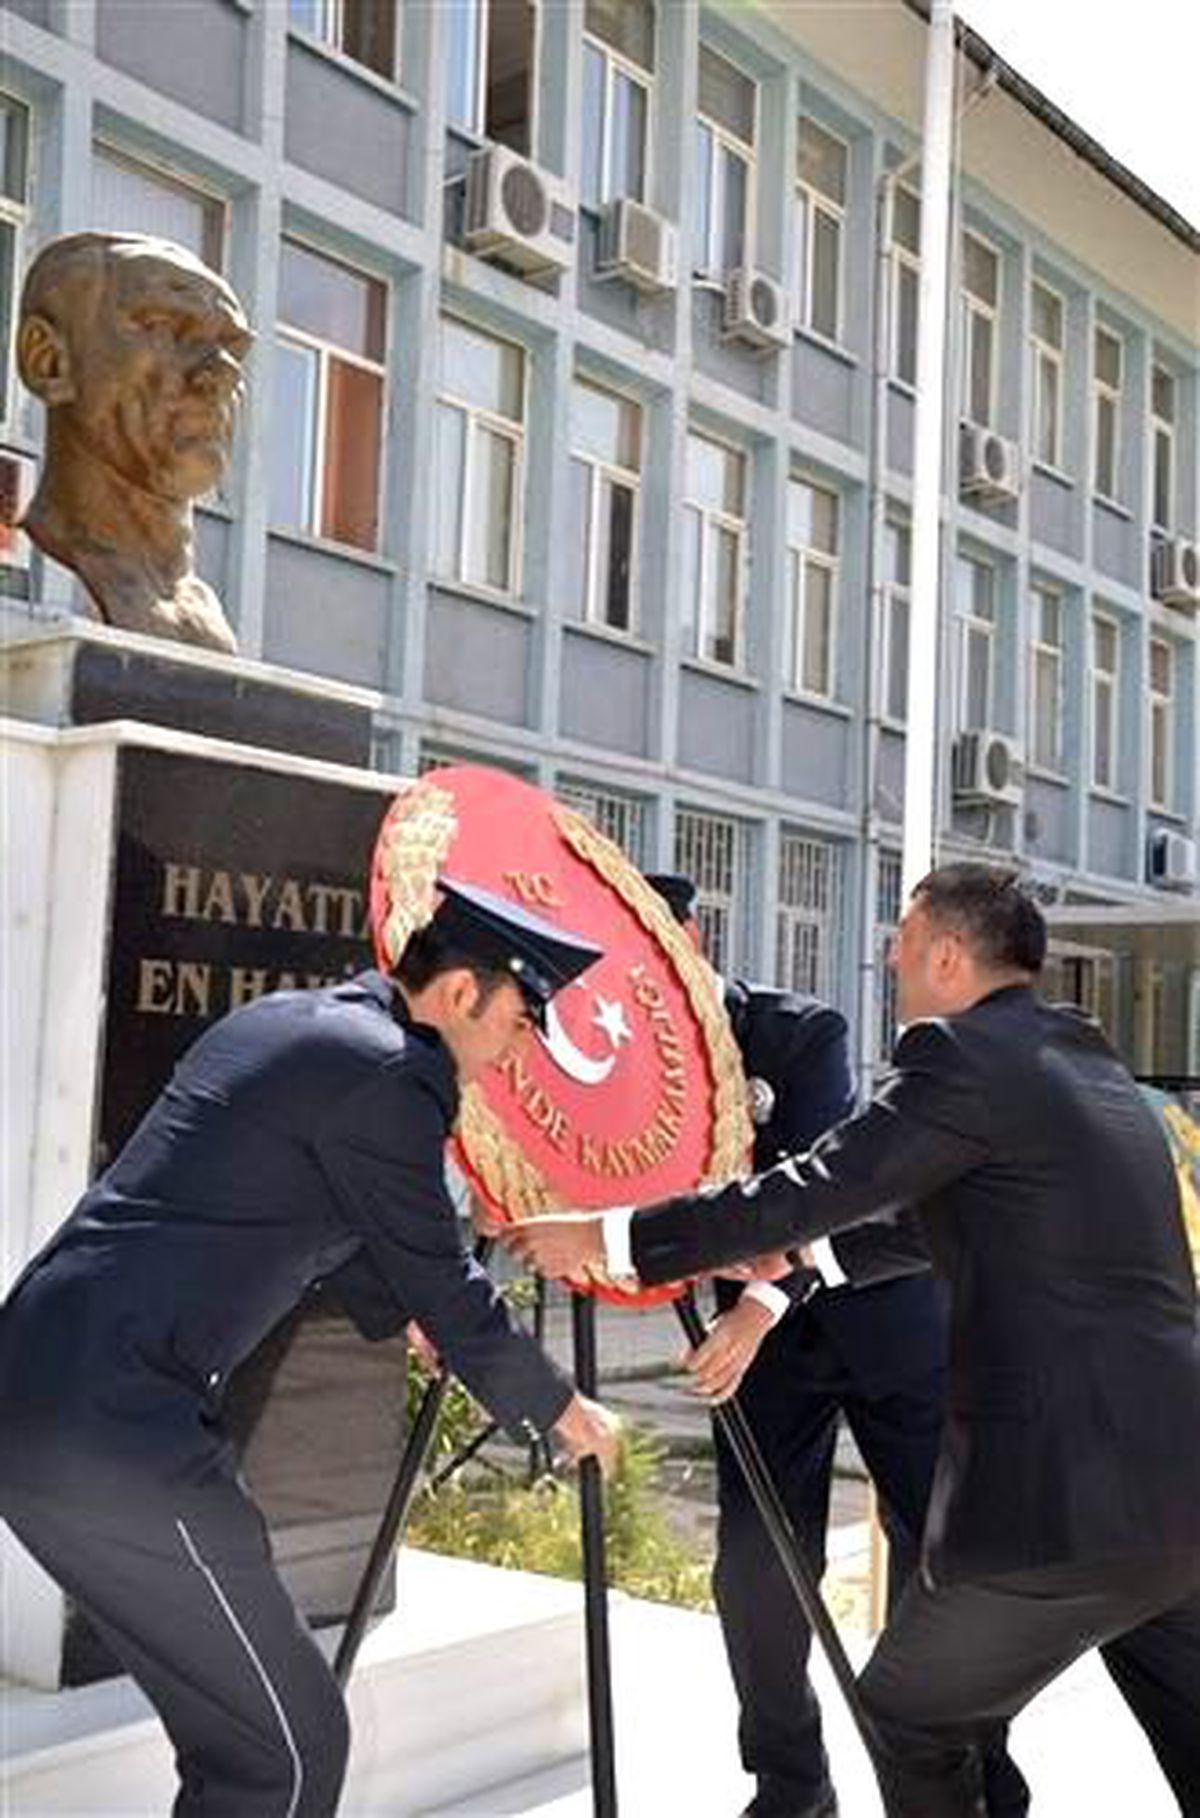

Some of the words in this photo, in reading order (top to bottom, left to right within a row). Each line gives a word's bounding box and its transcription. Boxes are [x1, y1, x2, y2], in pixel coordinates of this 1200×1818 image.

[161, 862, 371, 938] HAYATT
[138, 959, 210, 1016] EN
[501, 1053, 570, 1152] NDE
